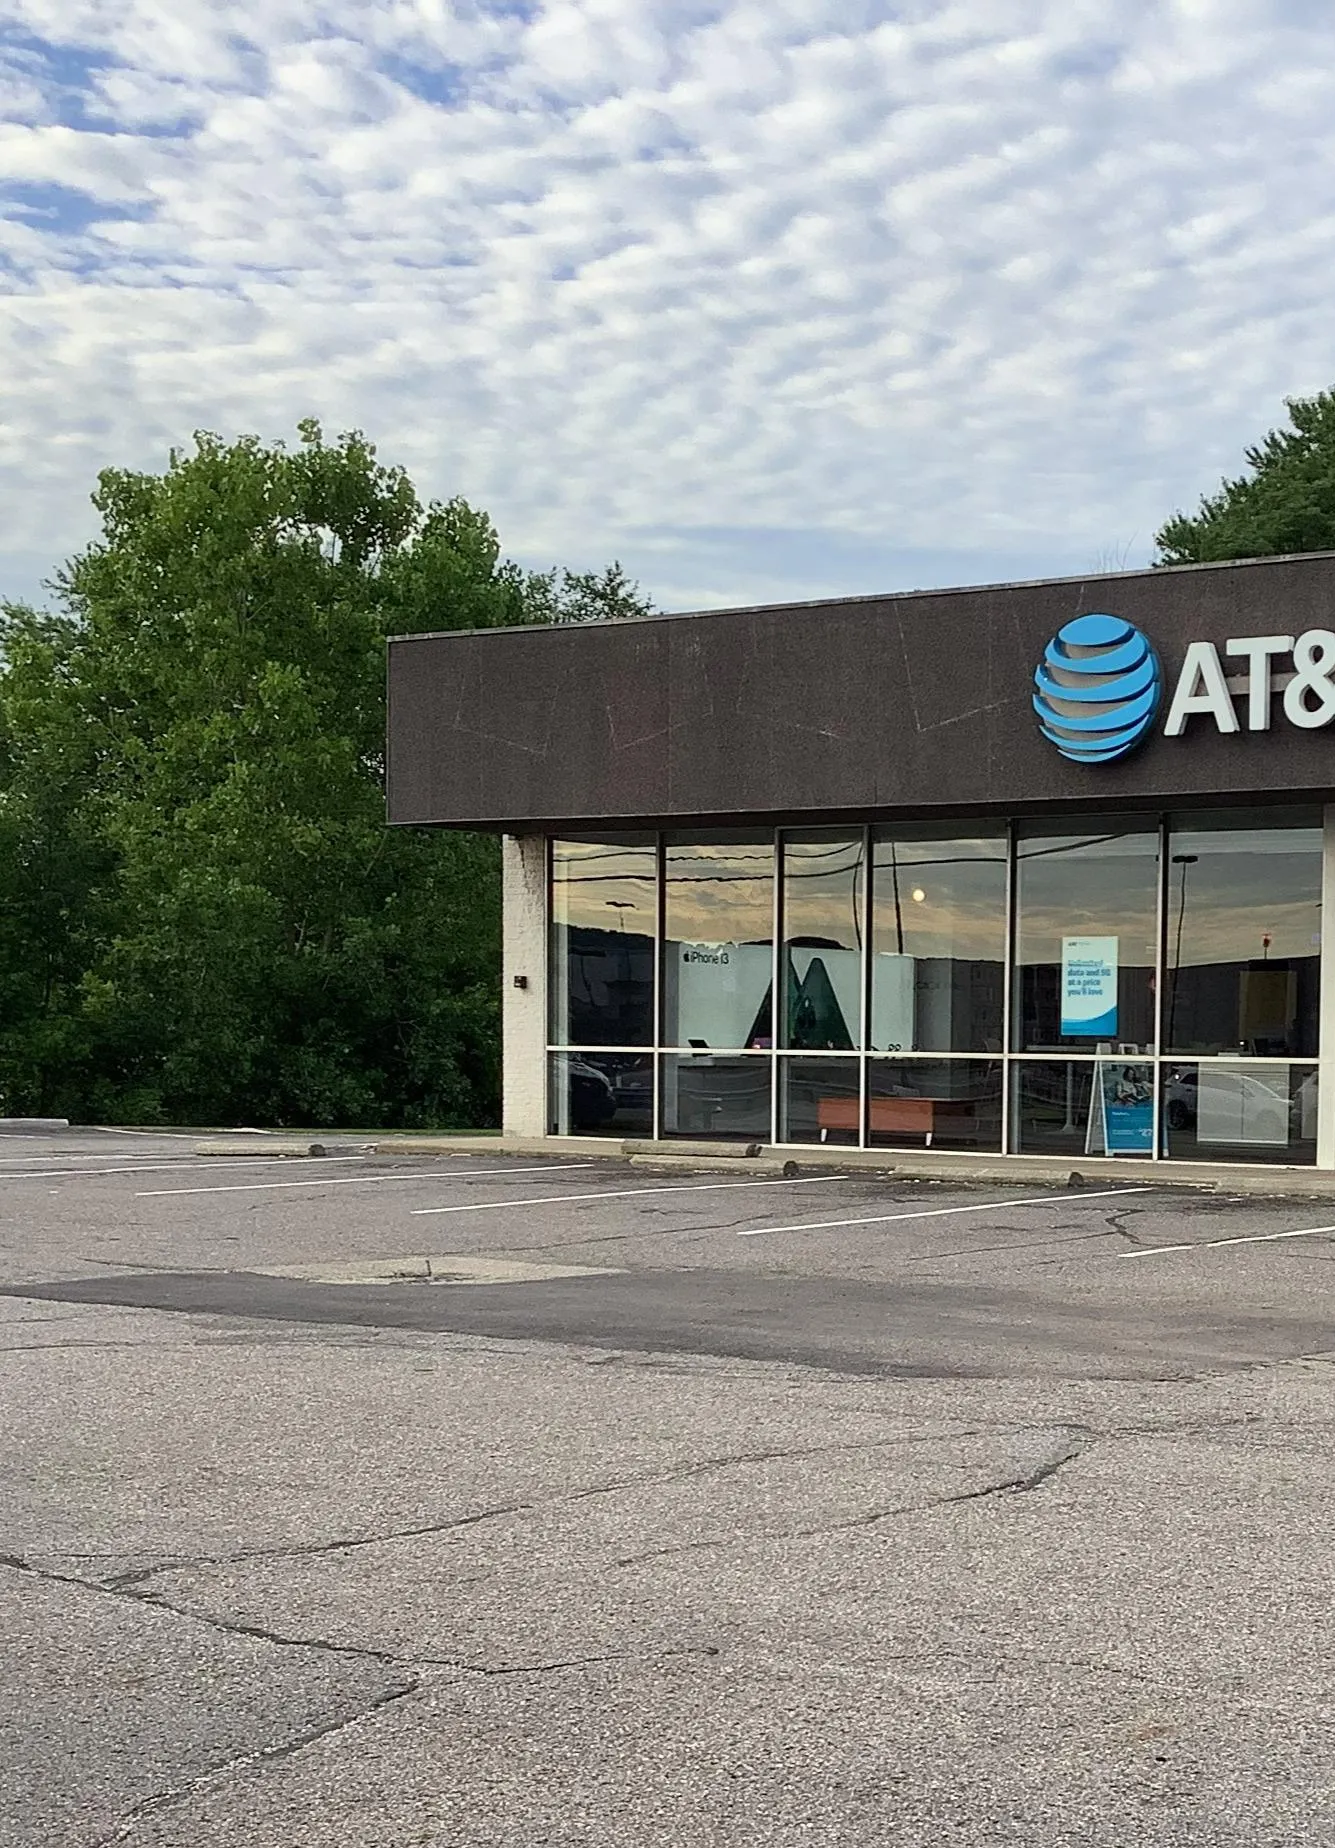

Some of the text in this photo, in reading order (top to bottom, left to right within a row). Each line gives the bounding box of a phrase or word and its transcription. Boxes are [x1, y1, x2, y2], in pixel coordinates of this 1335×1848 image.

[690, 951, 730, 965] iPhone 13
[1067, 968, 1084, 977] data
[1086, 968, 1100, 977] and
[1083, 978, 1101, 988] price
